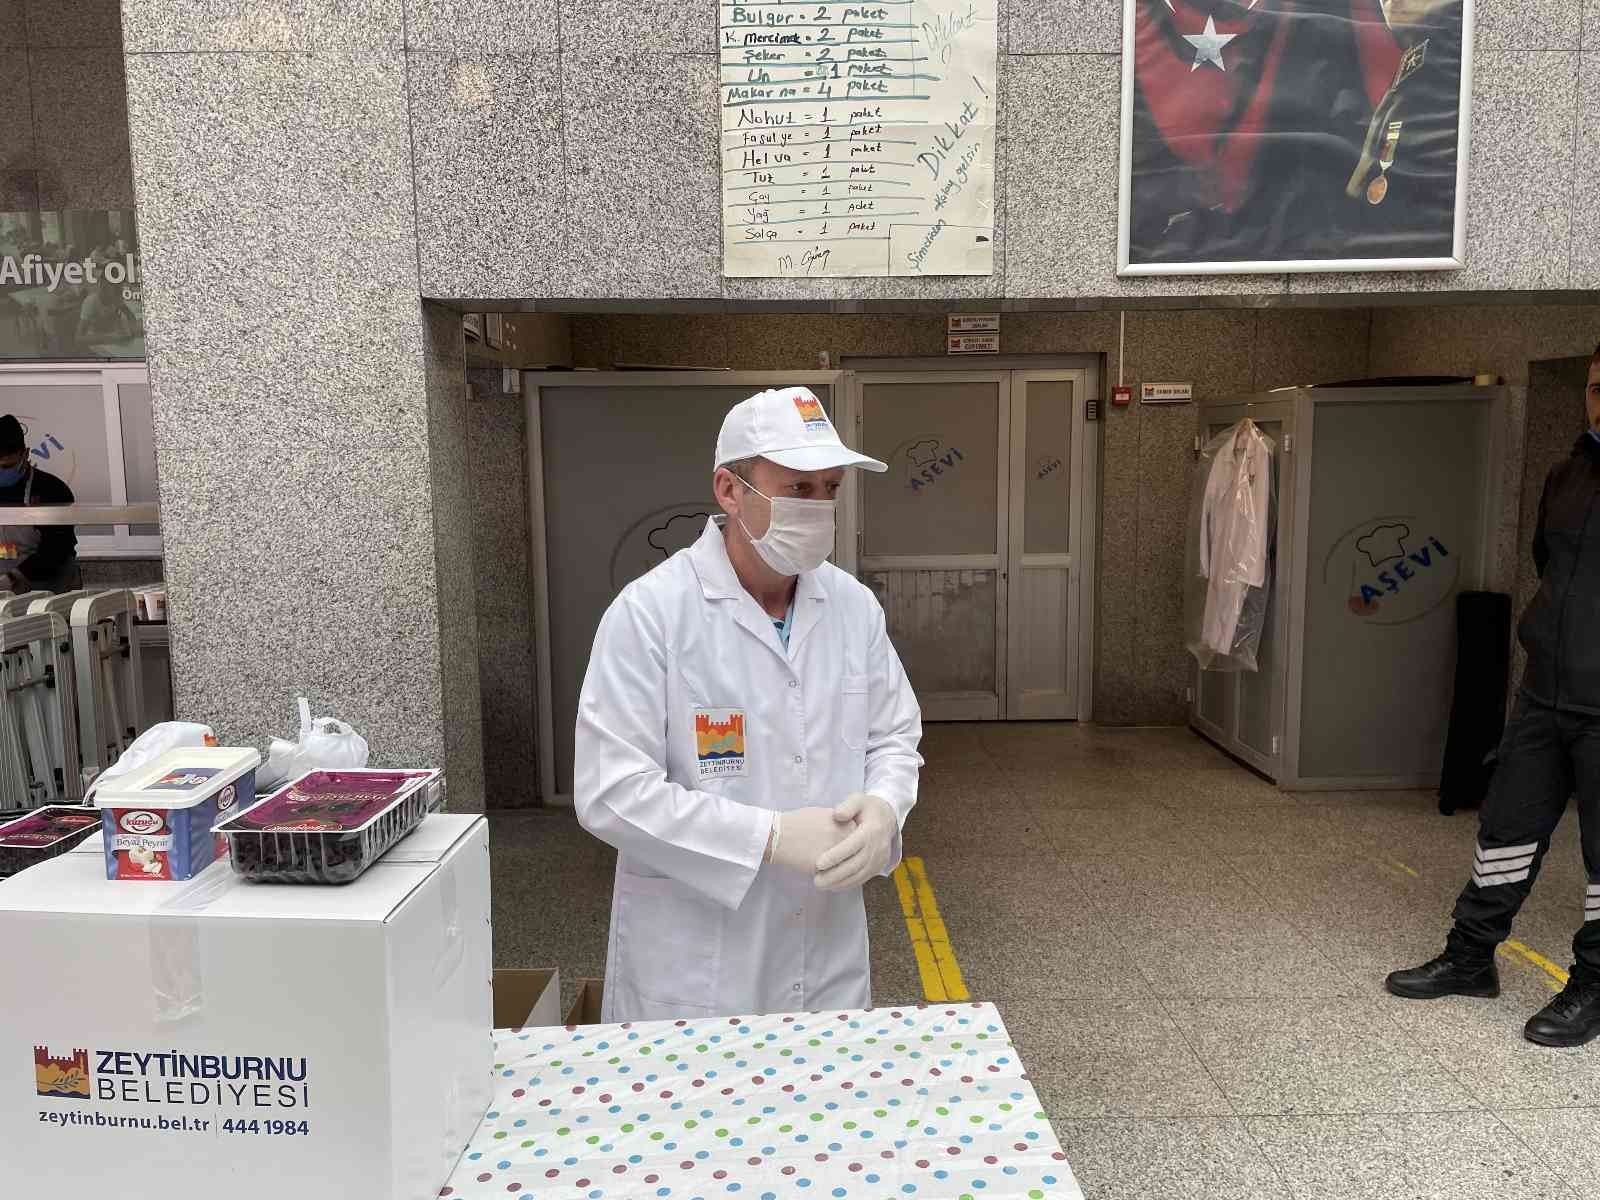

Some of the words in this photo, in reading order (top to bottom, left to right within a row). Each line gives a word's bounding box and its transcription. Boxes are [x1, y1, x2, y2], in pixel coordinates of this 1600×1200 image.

[733, 7, 793, 26] Bulgur
[813, 6, 832, 21] 2
[842, 5, 888, 24] paket
[817, 28, 835, 41] 2
[816, 48, 833, 62] 2
[817, 82, 831, 99] 4
[847, 79, 888, 99] paket
[738, 108, 797, 127] Nohut
[0, 254, 98, 293] Afiyet
[104, 253, 141, 284] ol
[1360, 536, 1449, 605] AŞEVİ
[96, 1050, 307, 1081] ZEYTİNBURNU
[97, 1078, 309, 1108] BELEDİYESİ
[39, 1110, 209, 1131] zeytinburnu.bel.tr
[222, 1118, 260, 1134] 444
[264, 1119, 310, 1135] 1984
